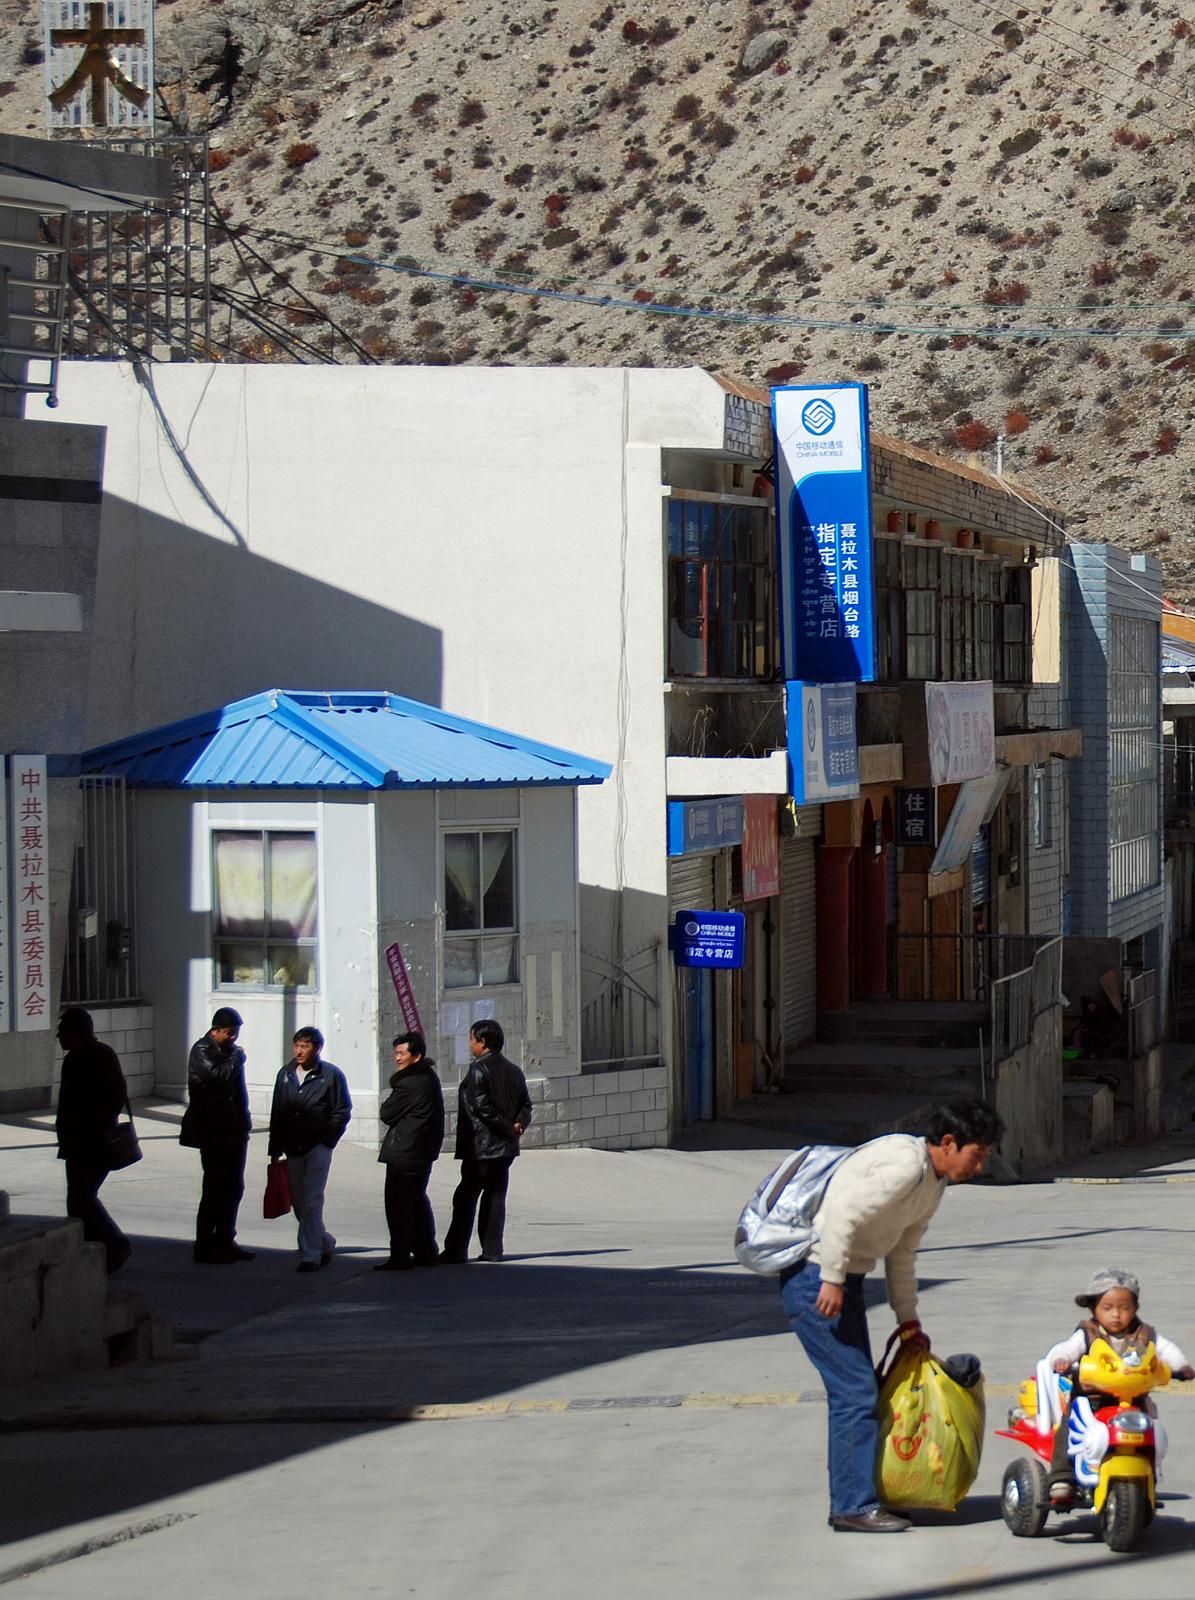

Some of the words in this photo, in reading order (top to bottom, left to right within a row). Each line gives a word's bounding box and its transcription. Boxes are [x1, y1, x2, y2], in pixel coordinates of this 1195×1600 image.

[795, 440, 844, 451] 中国移动通信
[817, 523, 838, 638] 指定专营店
[840, 522, 861, 639] 聂拉木县烟台路
[904, 792, 926, 838] 住宿
[20, 768, 46, 1016] 中共聂拉木县委员会
